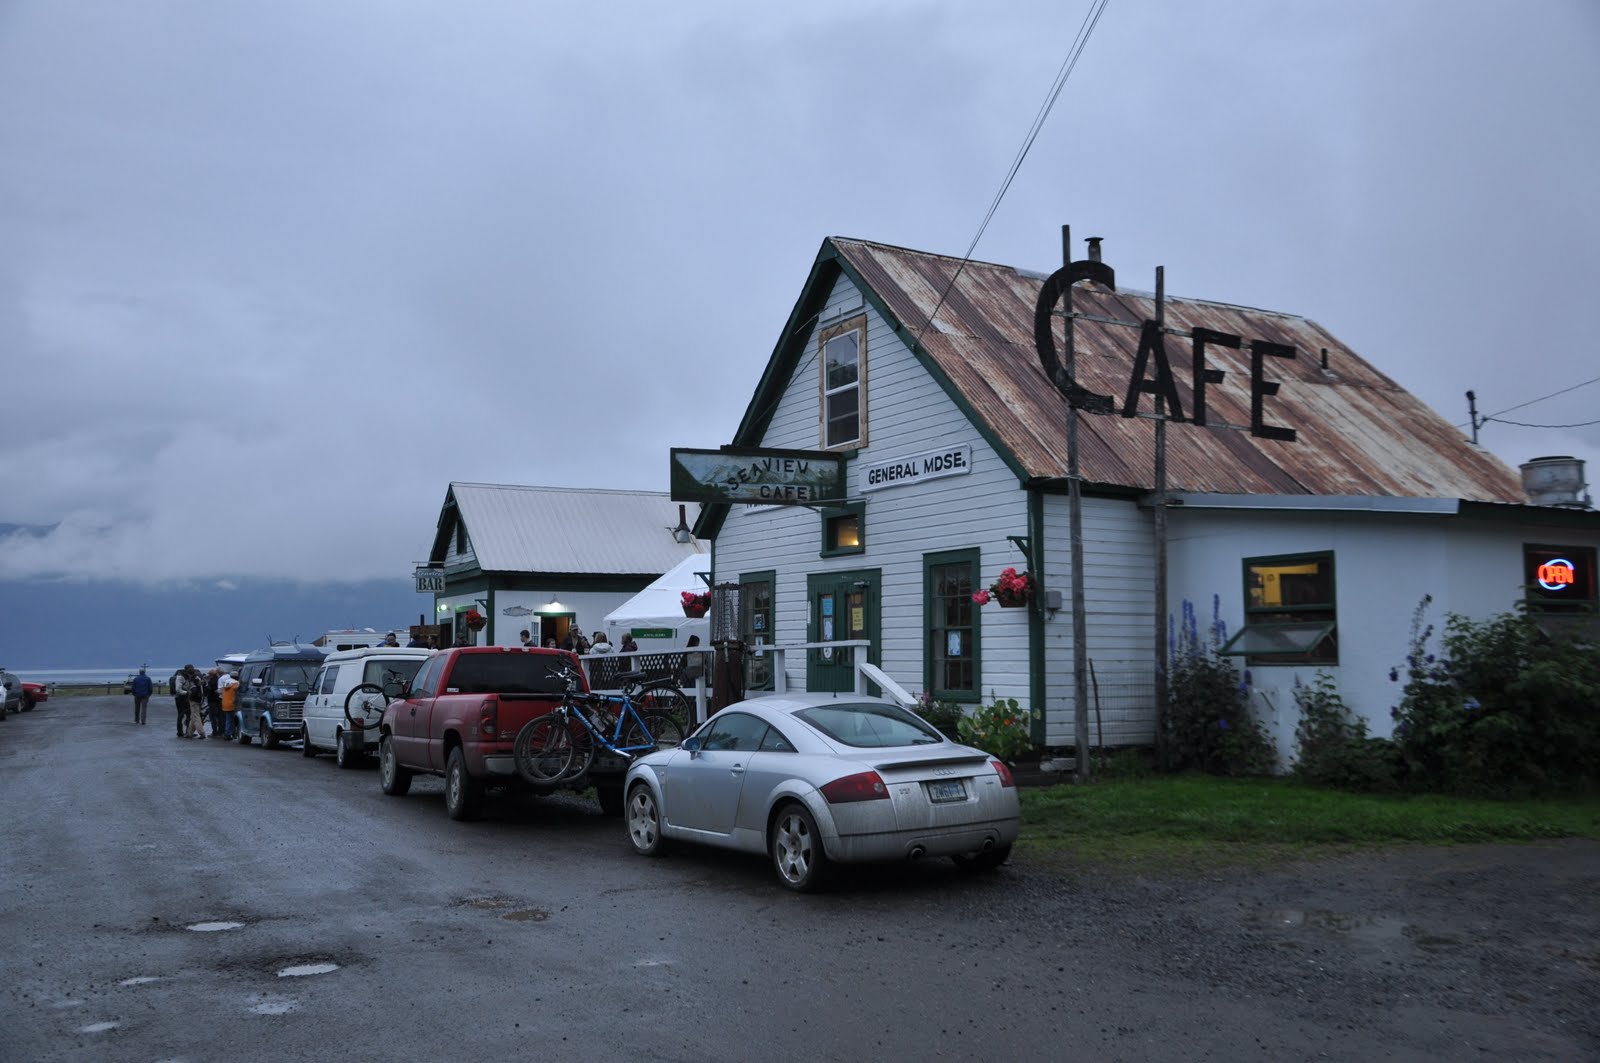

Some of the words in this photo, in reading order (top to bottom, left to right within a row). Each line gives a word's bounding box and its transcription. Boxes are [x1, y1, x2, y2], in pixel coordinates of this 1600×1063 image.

[1034, 259, 1296, 442] CAFE
[727, 458, 809, 491] SEAVIEW
[868, 461, 919, 485] GENERAL
[923, 452, 967, 474] MDSE.
[760, 485, 808, 500] CAFE
[418, 577, 443, 591] BAR
[1537, 564, 1574, 584] OPEN
